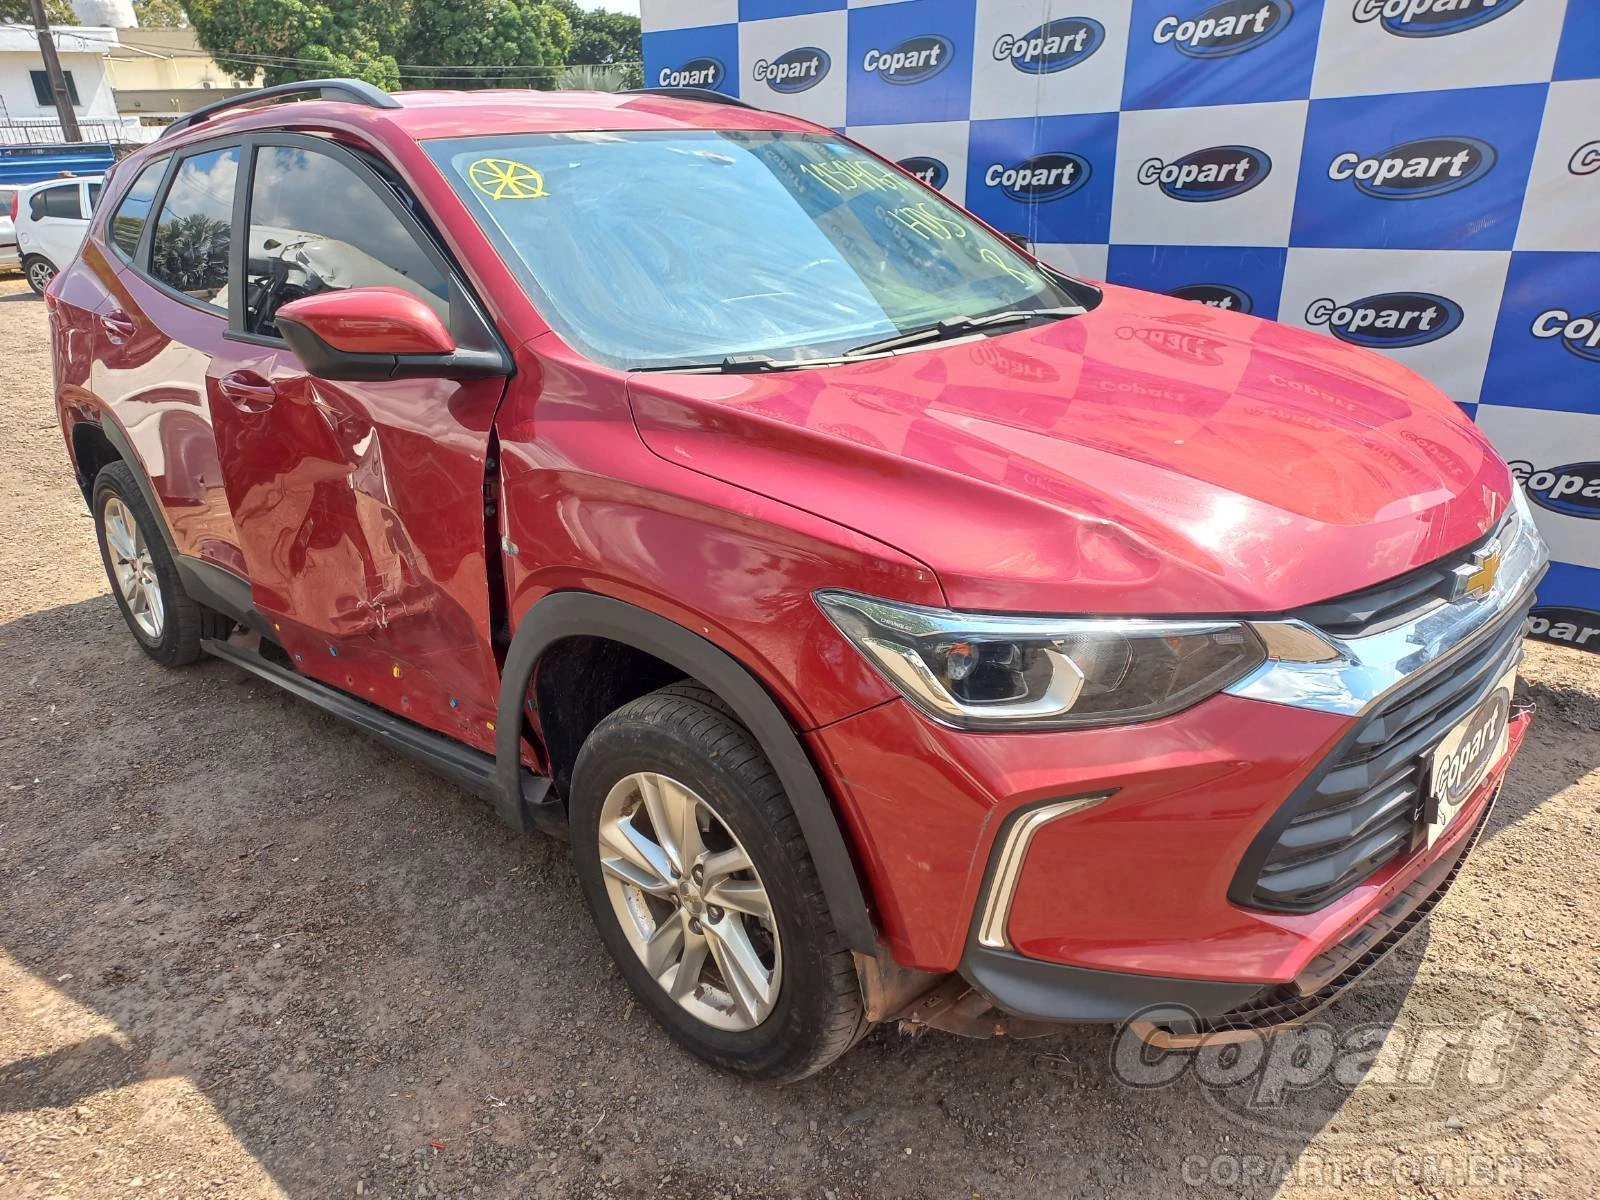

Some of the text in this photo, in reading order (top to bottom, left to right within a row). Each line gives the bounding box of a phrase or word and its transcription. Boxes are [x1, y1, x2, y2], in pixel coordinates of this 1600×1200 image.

[1152, 3, 1271, 46] Copart
[1353, 0, 1496, 23] Copa
[863, 44, 941, 75] Copart
[994, 27, 1087, 62] Copart
[658, 65, 716, 87] Copart
[754, 56, 819, 84] Copart
[984, 162, 1074, 191] Copart
[1138, 156, 1250, 189] Copart
[1328, 148, 1470, 186] Copart
[1305, 299, 1438, 334] Copart
[1435, 703, 1500, 796] Copart
